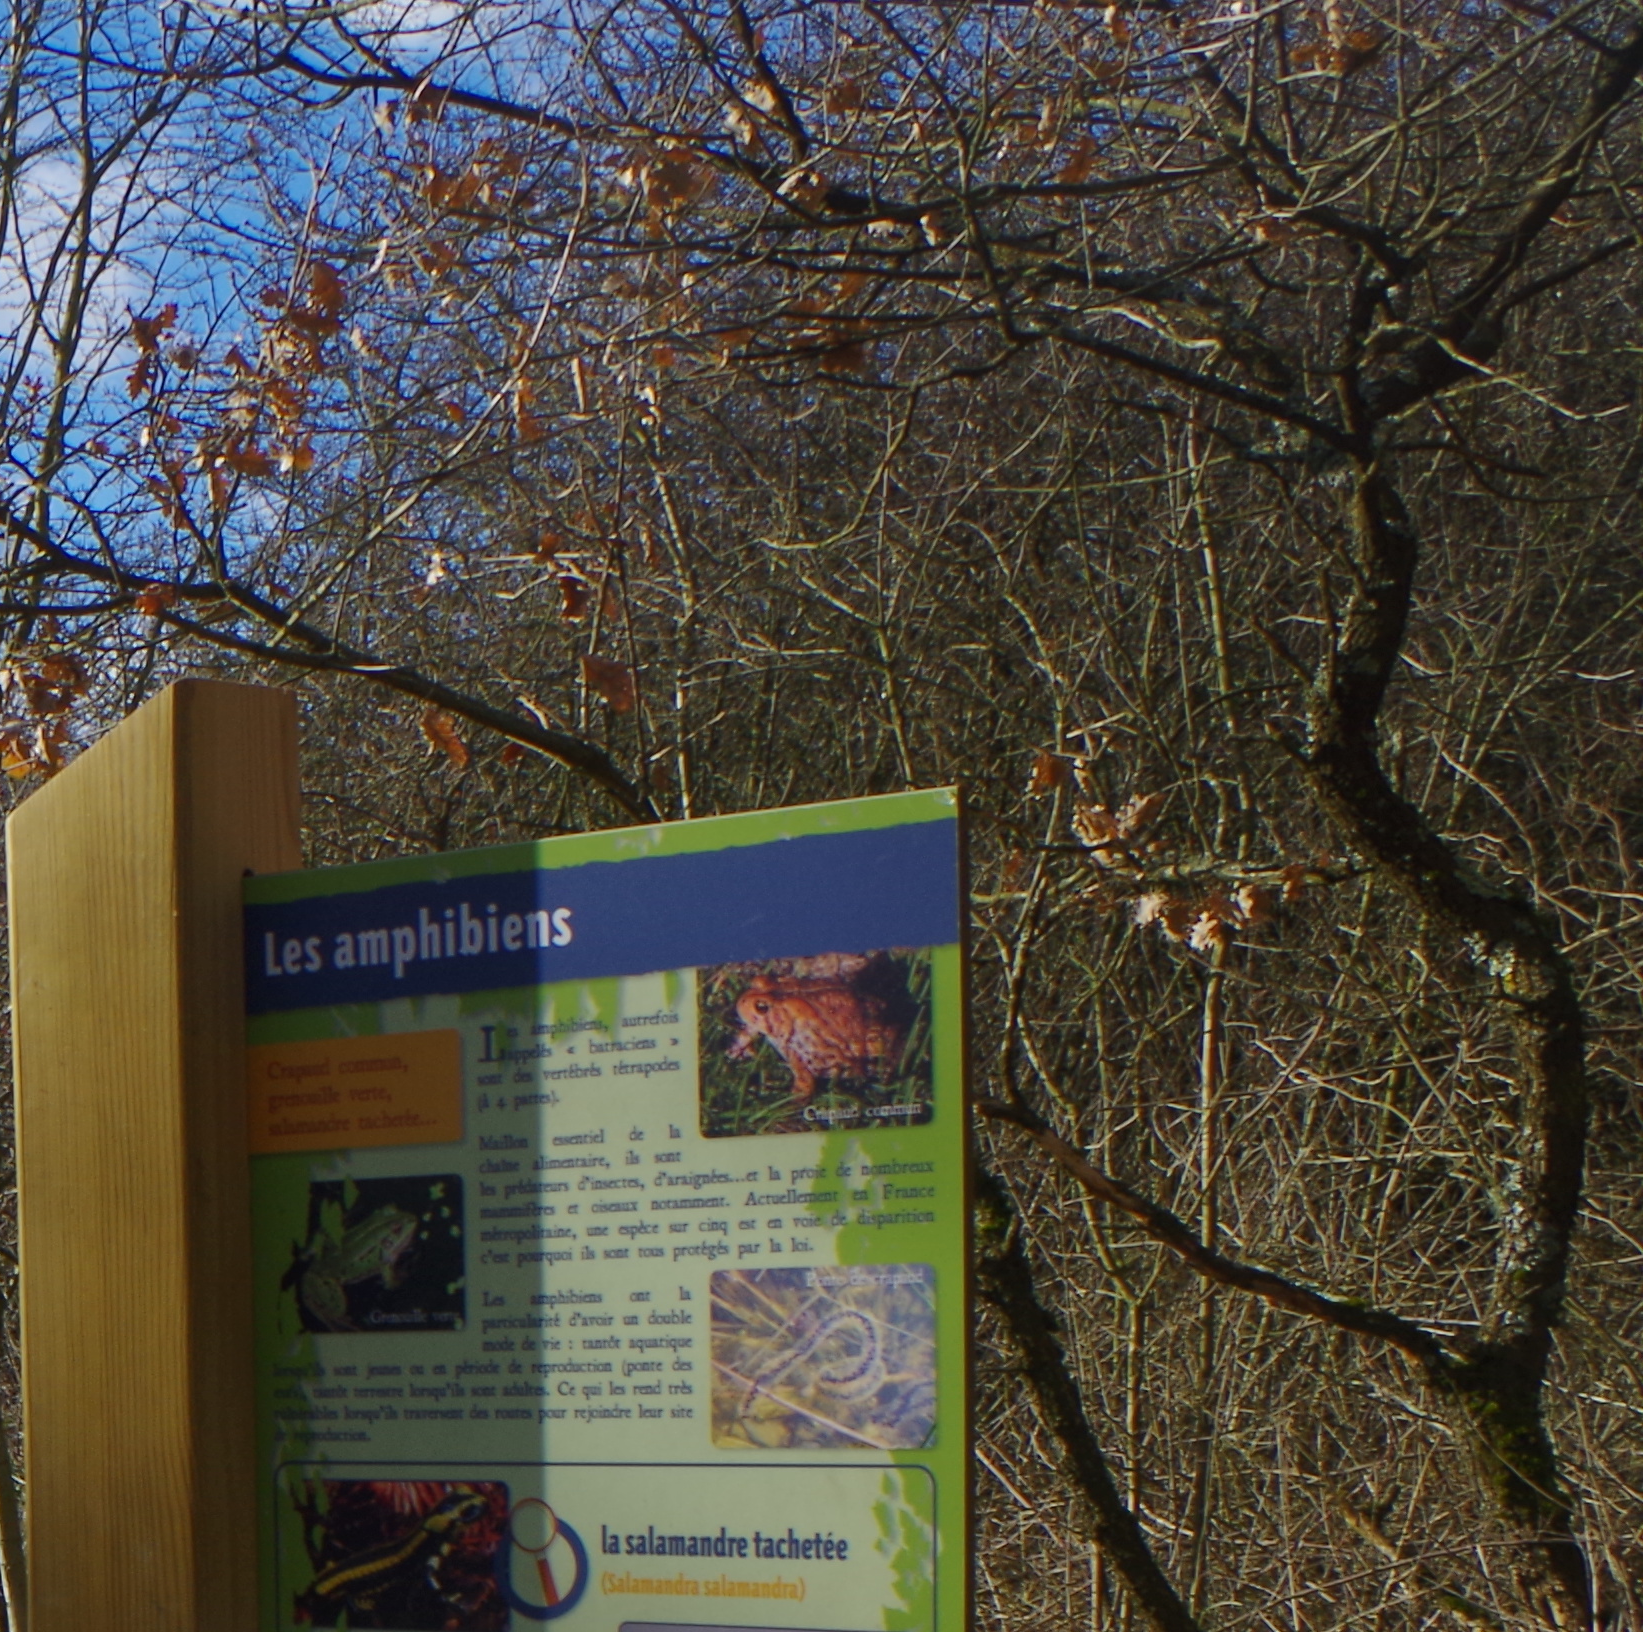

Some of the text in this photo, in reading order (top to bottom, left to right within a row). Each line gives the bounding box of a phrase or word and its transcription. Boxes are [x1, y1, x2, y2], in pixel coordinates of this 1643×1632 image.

[264, 901, 573, 978] Les amphibiens
[621, 1009, 679, 1028] autrefois
[588, 1036, 656, 1054] batraciens
[267, 1056, 330, 1084] Crapaud
[543, 1062, 601, 1081] vertébrés
[613, 1056, 679, 1078] tétrapodes
[267, 1085, 339, 1114] grenouille
[268, 1114, 350, 1136] salamandre
[551, 1128, 604, 1146] essentiel
[628, 1126, 645, 1142] de
[668, 1124, 681, 1139] la
[625, 1149, 640, 1165] ils
[653, 1151, 681, 1163] sont
[768, 1166, 781, 1181] la
[790, 1164, 826, 1185] proie
[835, 1162, 851, 1178] de
[860, 1159, 933, 1177] nombreux
[566, 1203, 578, 1214] et
[591, 1198, 637, 1213] oiseaux
[650, 1196, 729, 1210] notamment.
[744, 1188, 837, 1206] Actuellement
[850, 1190, 868, 1201] en
[882, 1184, 935, 1200] France
[586, 1226, 608, 1237] une
[617, 1219, 659, 1239] espèce
[668, 1222, 688, 1233] sur
[698, 1217, 728, 1236] cinq
[737, 1219, 755, 1231] est
[766, 1218, 782, 1229] en
[793, 1212, 821, 1228] voie
[830, 1211, 847, 1227] de
[857, 1208, 935, 1230] disparition
[516, 1245, 572, 1266] pourquoi
[581, 1244, 595, 1259] ils
[603, 1247, 629, 1259] sont
[637, 1246, 664, 1257] tous
[673, 1239, 729, 1261] protégés
[737, 1243, 760, 1259] par
[769, 1237, 782, 1253] la
[791, 1236, 813, 1252] loi.
[483, 1285, 692, 1309] Les amphibiens ont la
[622, 1315, 639, 1325] un
[647, 1308, 691, 1325] double
[521, 1335, 536, 1350] de
[542, 1335, 560, 1350] vie
[582, 1334, 620, 1349] tantôt
[628, 1333, 692, 1353] aquatique
[507, 1358, 522, 1373] de
[530, 1358, 612, 1377] reproduction
[671, 1356, 692, 1371] des
[556, 1381, 575, 1396] Ce
[581, 1381, 601, 1400] qui
[609, 1380, 625, 1395] les
[632, 1380, 661, 1395] rend
[668, 1379, 693, 1395] très
[538, 1408, 566, 1423] pour
[574, 1403, 631, 1423] rejoindre
[638, 1403, 663, 1418] leur
[670, 1403, 692, 1418] site
[601, 1524, 849, 1561] la salamandre tachetée
[601, 1571, 805, 1602] (Salamandra salamandra)
